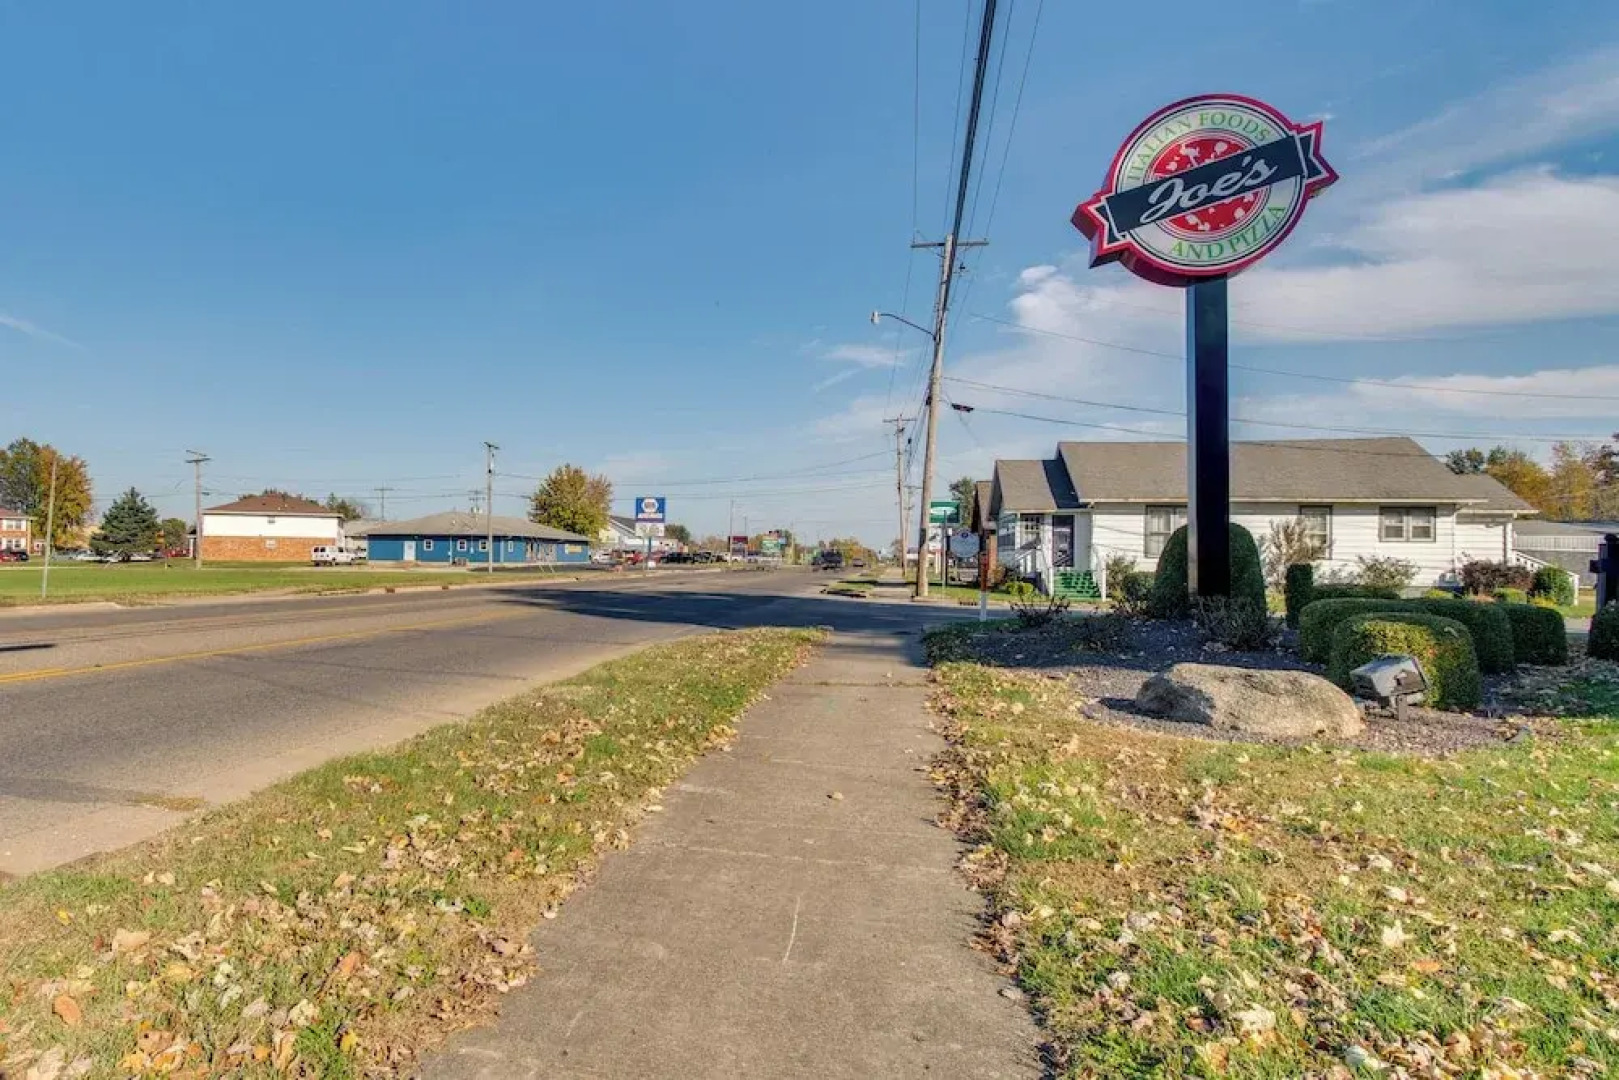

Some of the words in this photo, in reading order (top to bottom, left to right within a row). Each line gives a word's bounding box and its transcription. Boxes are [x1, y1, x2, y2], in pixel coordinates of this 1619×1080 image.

[1127, 117, 1192, 182] ITALIAN
[1199, 111, 1272, 143] FOODS
[1140, 155, 1278, 223] Joe's
[1172, 239, 1223, 260] AND
[1230, 205, 1286, 253] PIZZA
